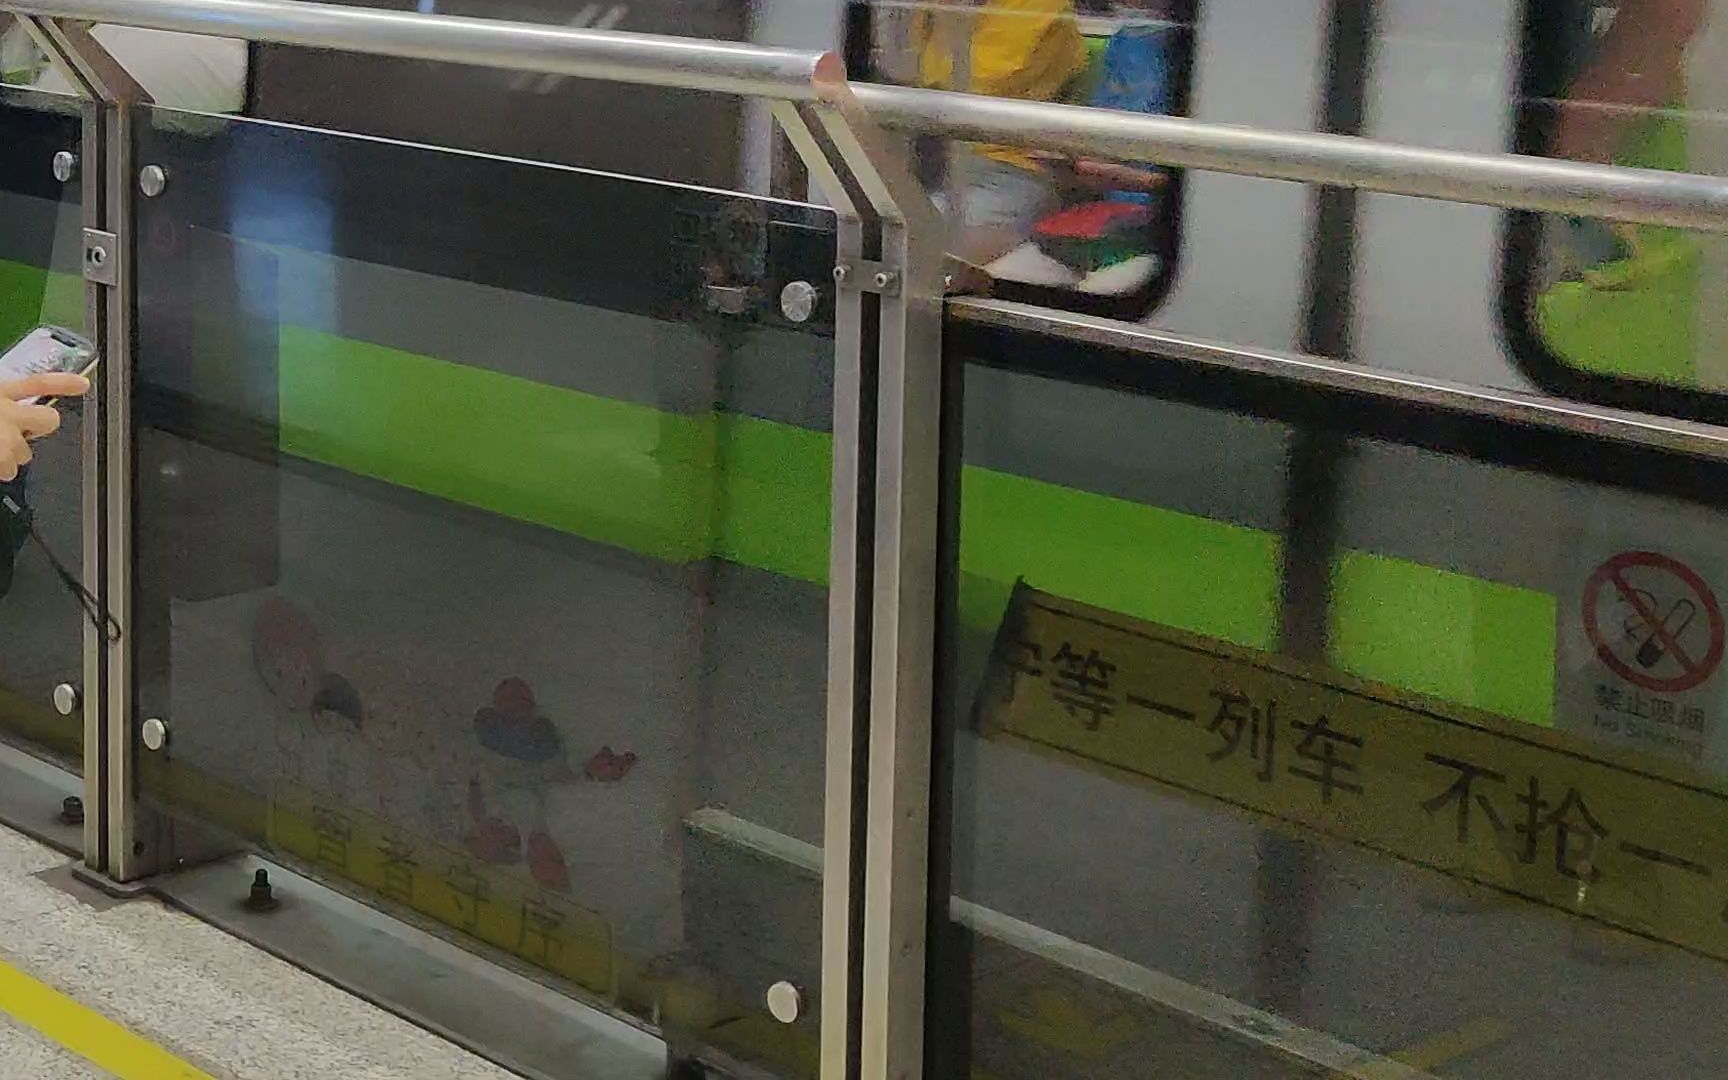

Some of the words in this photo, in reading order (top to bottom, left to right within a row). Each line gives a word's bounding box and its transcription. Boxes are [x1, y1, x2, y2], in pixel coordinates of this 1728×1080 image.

[1593, 683, 1705, 733] 禁止吸烟
[1420, 751, 1728, 917] 不抢一
